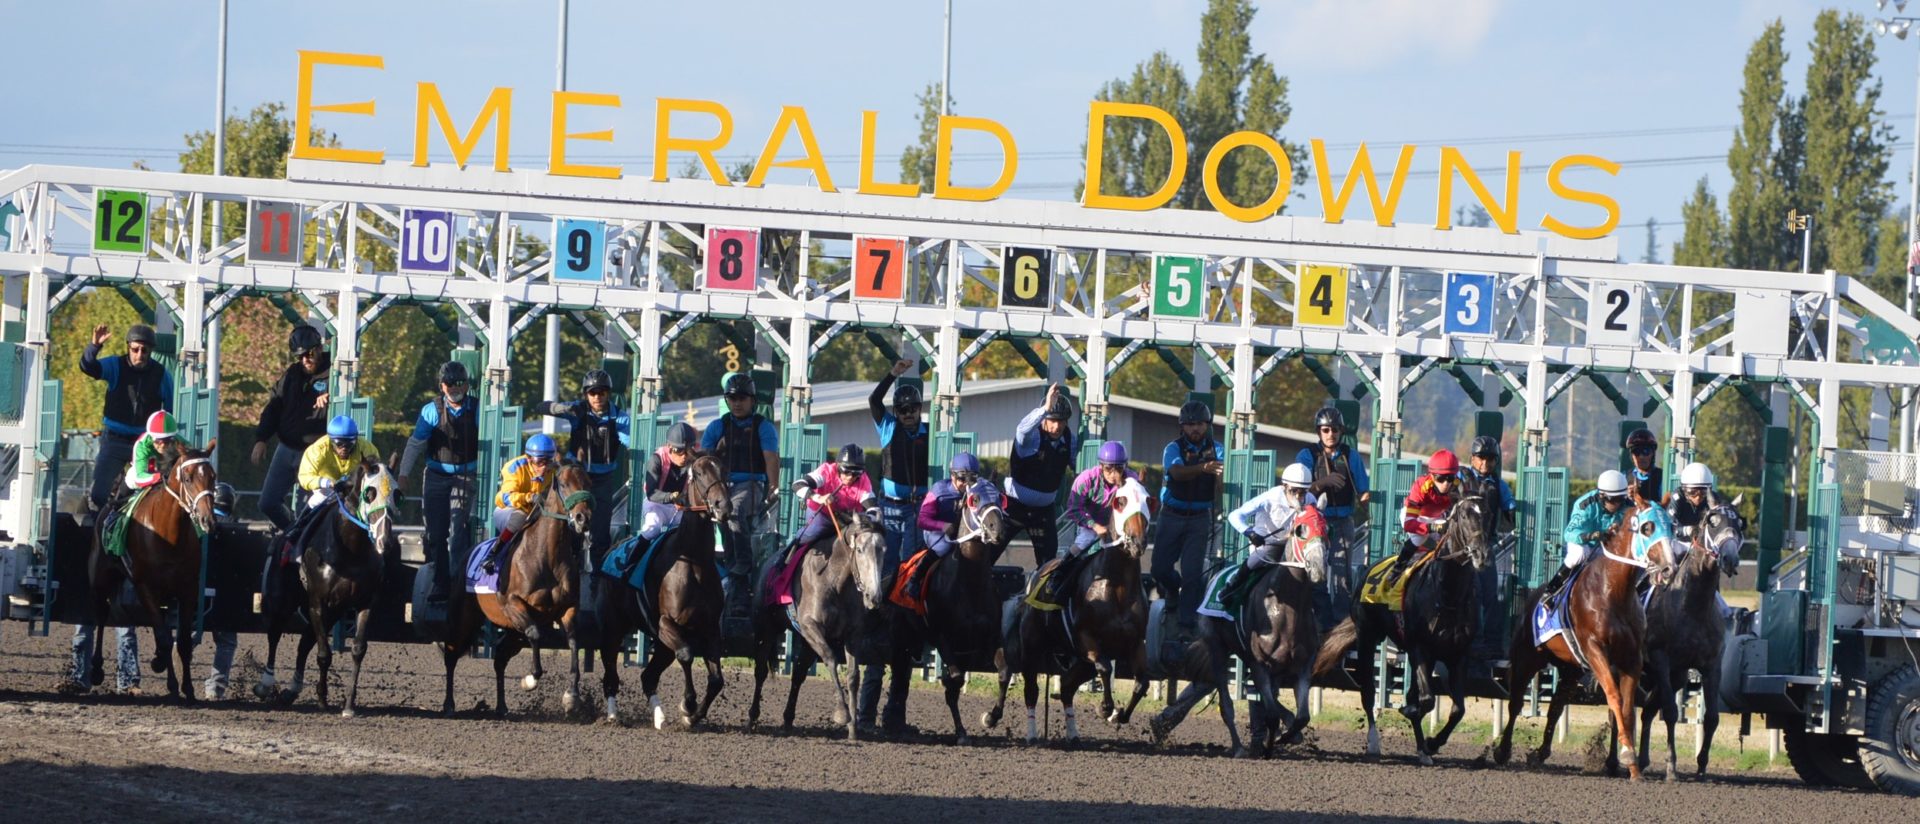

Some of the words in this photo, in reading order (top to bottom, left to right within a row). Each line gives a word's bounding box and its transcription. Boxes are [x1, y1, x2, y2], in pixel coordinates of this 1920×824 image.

[291, 49, 1019, 203] EMERALD
[1083, 100, 1622, 241] DOWNS
[98, 198, 144, 244] 12
[258, 209, 292, 254] 11
[404, 217, 450, 263] 10
[566, 228, 592, 272] 9
[718, 237, 743, 281] 8
[868, 248, 892, 291] 7
[1014, 255, 1040, 300] 6
[1166, 264, 1193, 309] 5
[1308, 274, 1334, 316] 4
[1456, 282, 1481, 326] 3
[1604, 288, 1630, 331] 2
